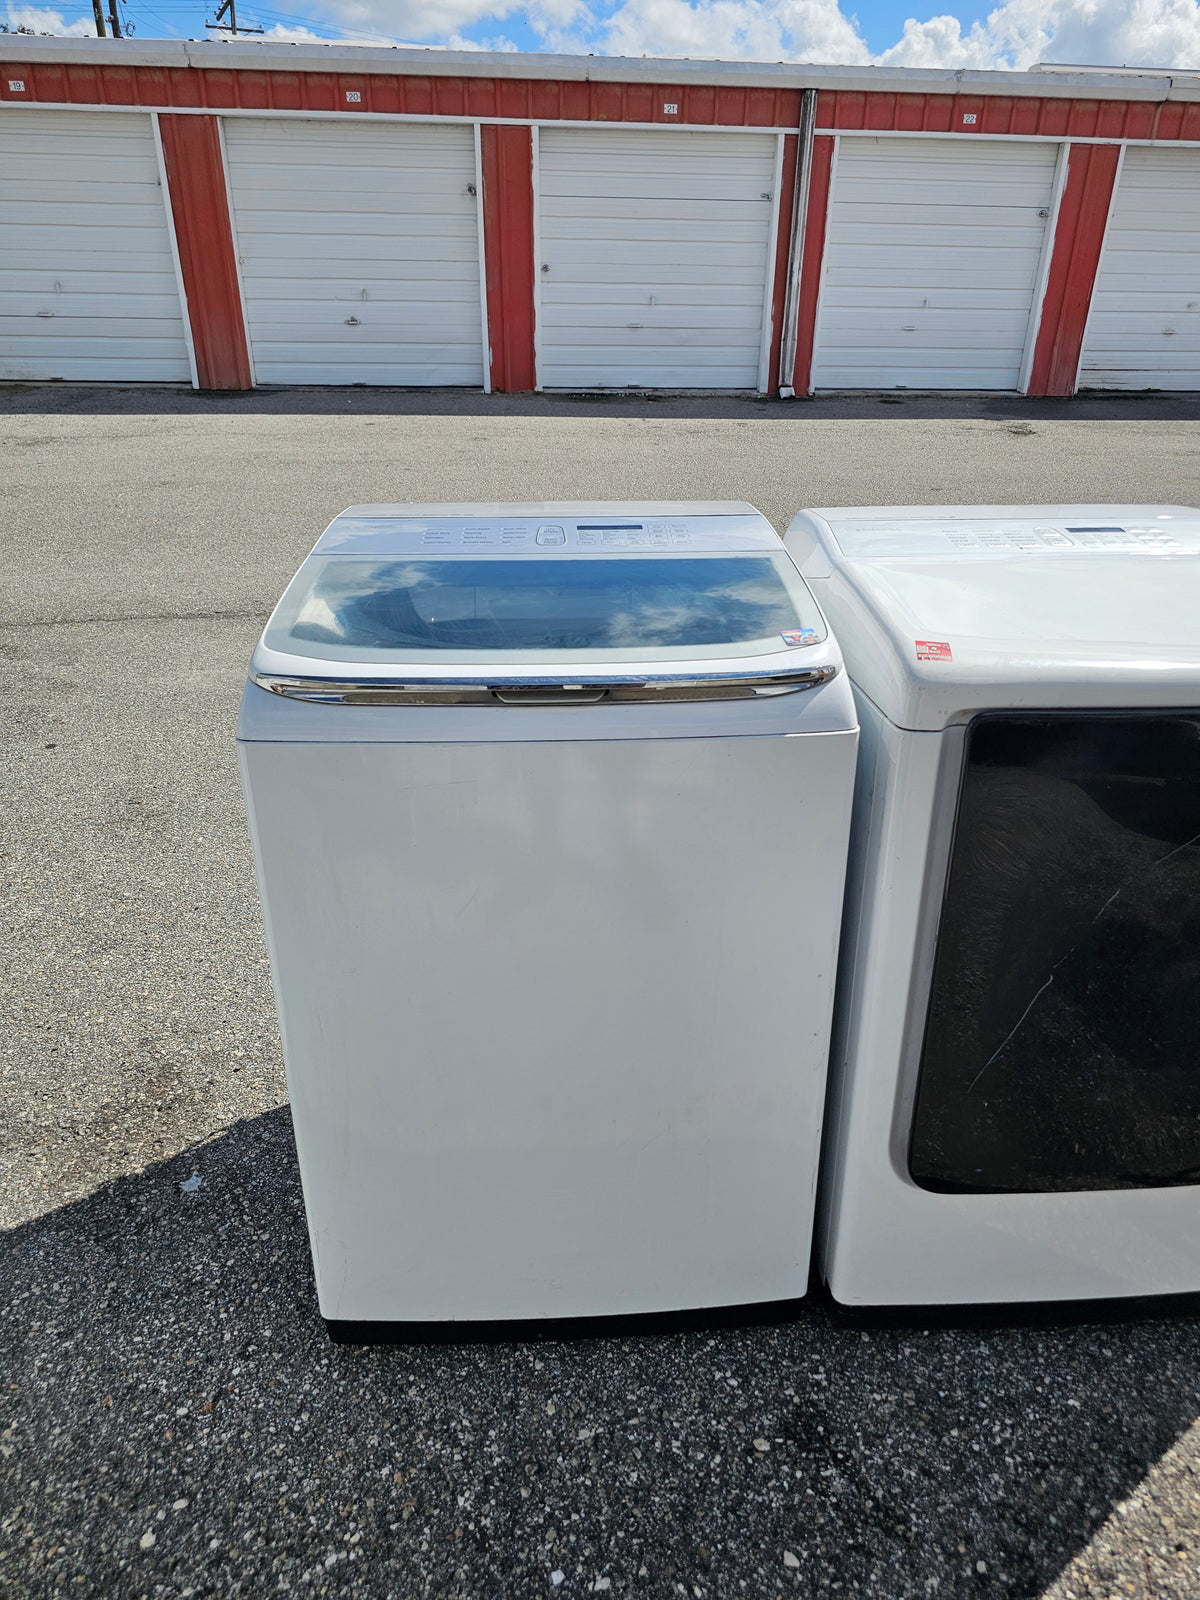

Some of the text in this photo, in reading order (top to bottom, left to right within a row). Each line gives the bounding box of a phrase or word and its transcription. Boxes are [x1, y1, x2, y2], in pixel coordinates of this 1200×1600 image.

[12, 81, 22, 91] 19
[347, 92, 359, 101] 20
[666, 104, 676, 113] 21
[965, 114, 975, 123] 22
